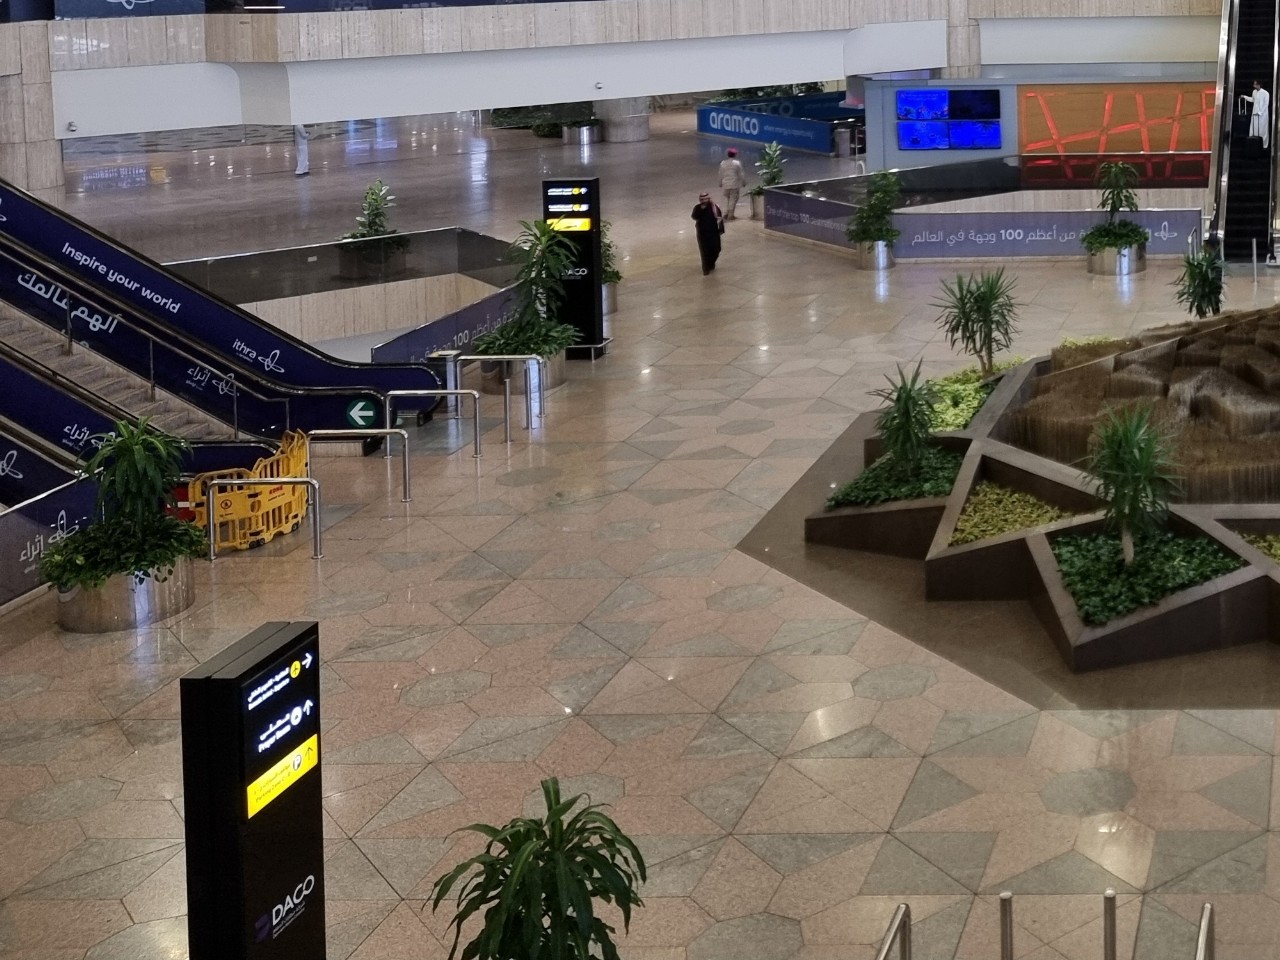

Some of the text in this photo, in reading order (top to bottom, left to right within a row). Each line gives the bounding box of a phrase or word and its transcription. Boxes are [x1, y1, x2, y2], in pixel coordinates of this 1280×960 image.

[709, 112, 758, 135] aramco
[912, 231, 943, 246] العالم
[946, 229, 965, 246] في
[968, 230, 996, 244] وجهة
[1000, 229, 1024, 240] 100
[1026, 225, 1057, 243] أعظم
[1059, 230, 1076, 243] من
[62, 242, 181, 314] Inspire your world
[71, 306, 122, 334] ألهم
[453, 329, 470, 348] 100
[232, 339, 257, 359] ithra
[187, 366, 211, 387] إثراء
[64, 424, 90, 447] إثراء
[19, 534, 48, 562] إثراء
[272, 874, 315, 926] DACO
